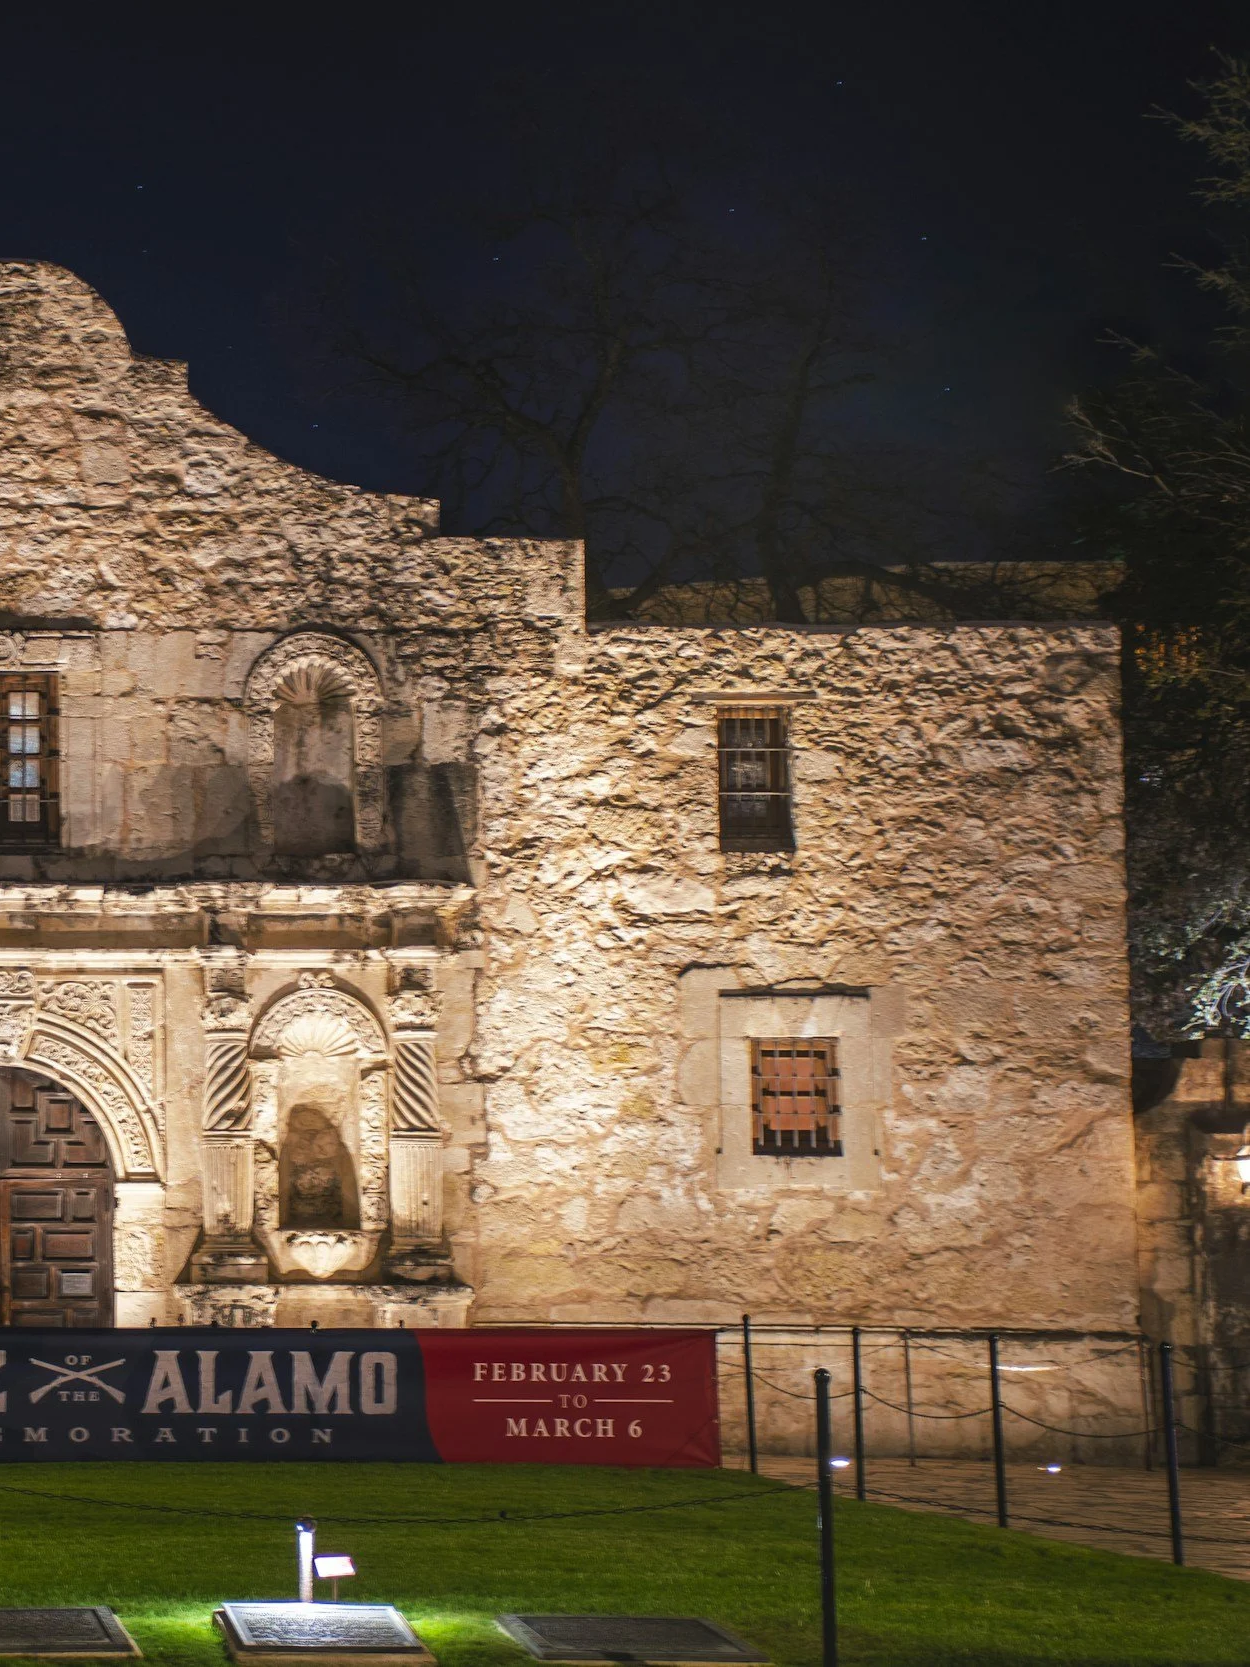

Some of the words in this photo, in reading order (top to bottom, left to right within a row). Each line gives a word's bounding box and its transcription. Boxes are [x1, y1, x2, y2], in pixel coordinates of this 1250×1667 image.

[65, 1355, 92, 1366] OF
[473, 1363, 629, 1382] FEBRUARY
[641, 1364, 672, 1382] 23
[140, 1350, 398, 1415] ALAMO
[58, 1391, 98, 1402] THE
[558, 1394, 588, 1409] TO
[505, 1418, 616, 1437] MARCH
[628, 1420, 643, 1438] 6
